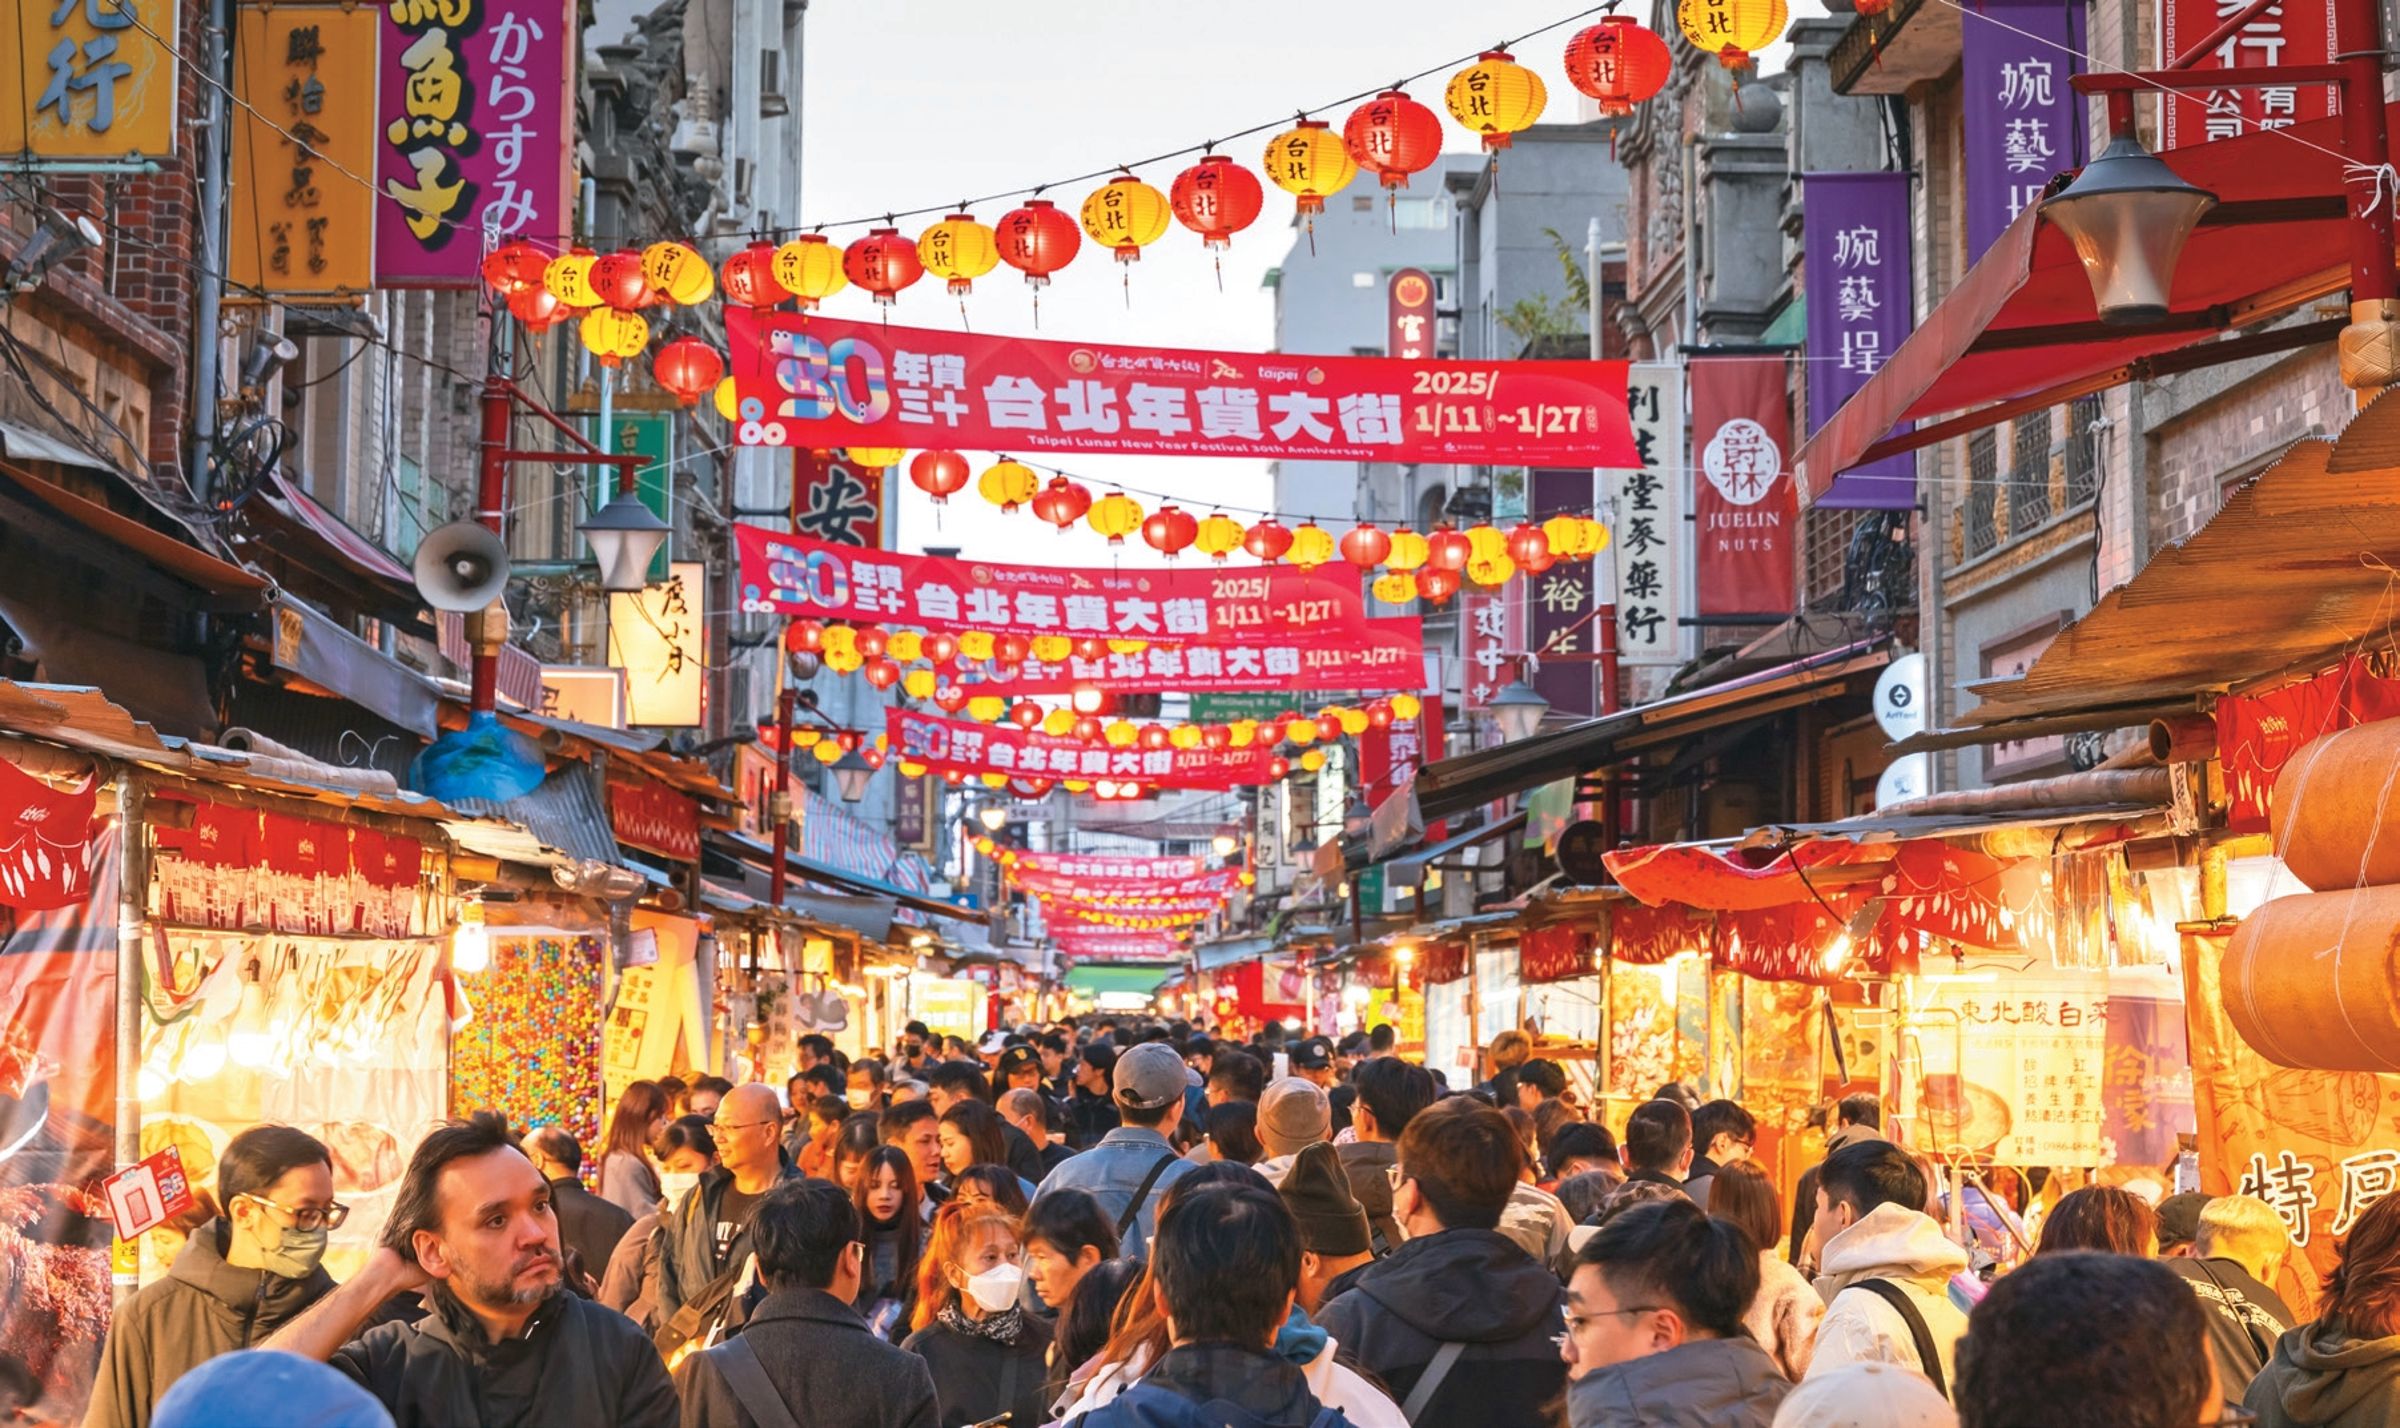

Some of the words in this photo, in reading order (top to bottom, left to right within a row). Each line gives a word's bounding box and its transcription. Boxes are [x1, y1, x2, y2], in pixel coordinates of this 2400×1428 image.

[2216, 0, 2287, 68] 行
[1592, 32, 1616, 85] 台北
[1467, 70, 1491, 116] 台北
[483, 12, 544, 235] からすみ
[1370, 104, 1393, 155] 台北
[1287, 138, 1309, 180] 台北
[1103, 189, 1126, 230] 台北
[1196, 170, 1217, 216] 台北
[931, 230, 952, 267] 台北
[1012, 215, 1033, 259] 台北
[562, 266, 578, 298] 台北
[655, 247, 682, 282] 台北
[733, 257, 752, 295] 台北
[782, 251, 799, 288] 台北
[863, 245, 881, 282] 台北
[1833, 224, 1881, 375] 婉藝埕
[893, 350, 967, 390] 年貨
[1412, 370, 1499, 401] 2025/
[898, 390, 969, 428] 三十
[983, 376, 1405, 444] 台北年貨大街
[1414, 402, 1482, 437] 1/11
[1027, 435, 1072, 446] Taipei
[1076, 437, 1117, 448] Lunar
[1121, 440, 1153, 449] New
[1155, 441, 1188, 450] Year
[1191, 442, 1248, 452] Festival
[1251, 444, 1285, 453] 30th
[1287, 446, 1374, 457] Anniversary
[1721, 424, 1765, 497] 爵林
[797, 448, 877, 547] 安
[1707, 511, 1780, 531] JUELIN
[1718, 538, 1772, 551] NUTS
[851, 560, 905, 591] 年貨
[1211, 576, 1270, 600] 2025/
[854, 587, 906, 614] 三十
[914, 582, 1209, 635] 台北年貨大街
[1216, 604, 1263, 629] 1/11
[1056, 630, 1097, 639] Festival
[1124, 634, 1185, 644] Anniversary
[988, 742, 1173, 775] 台北年貨大街
[1961, 1000, 2120, 1027] 東北酸白菜
